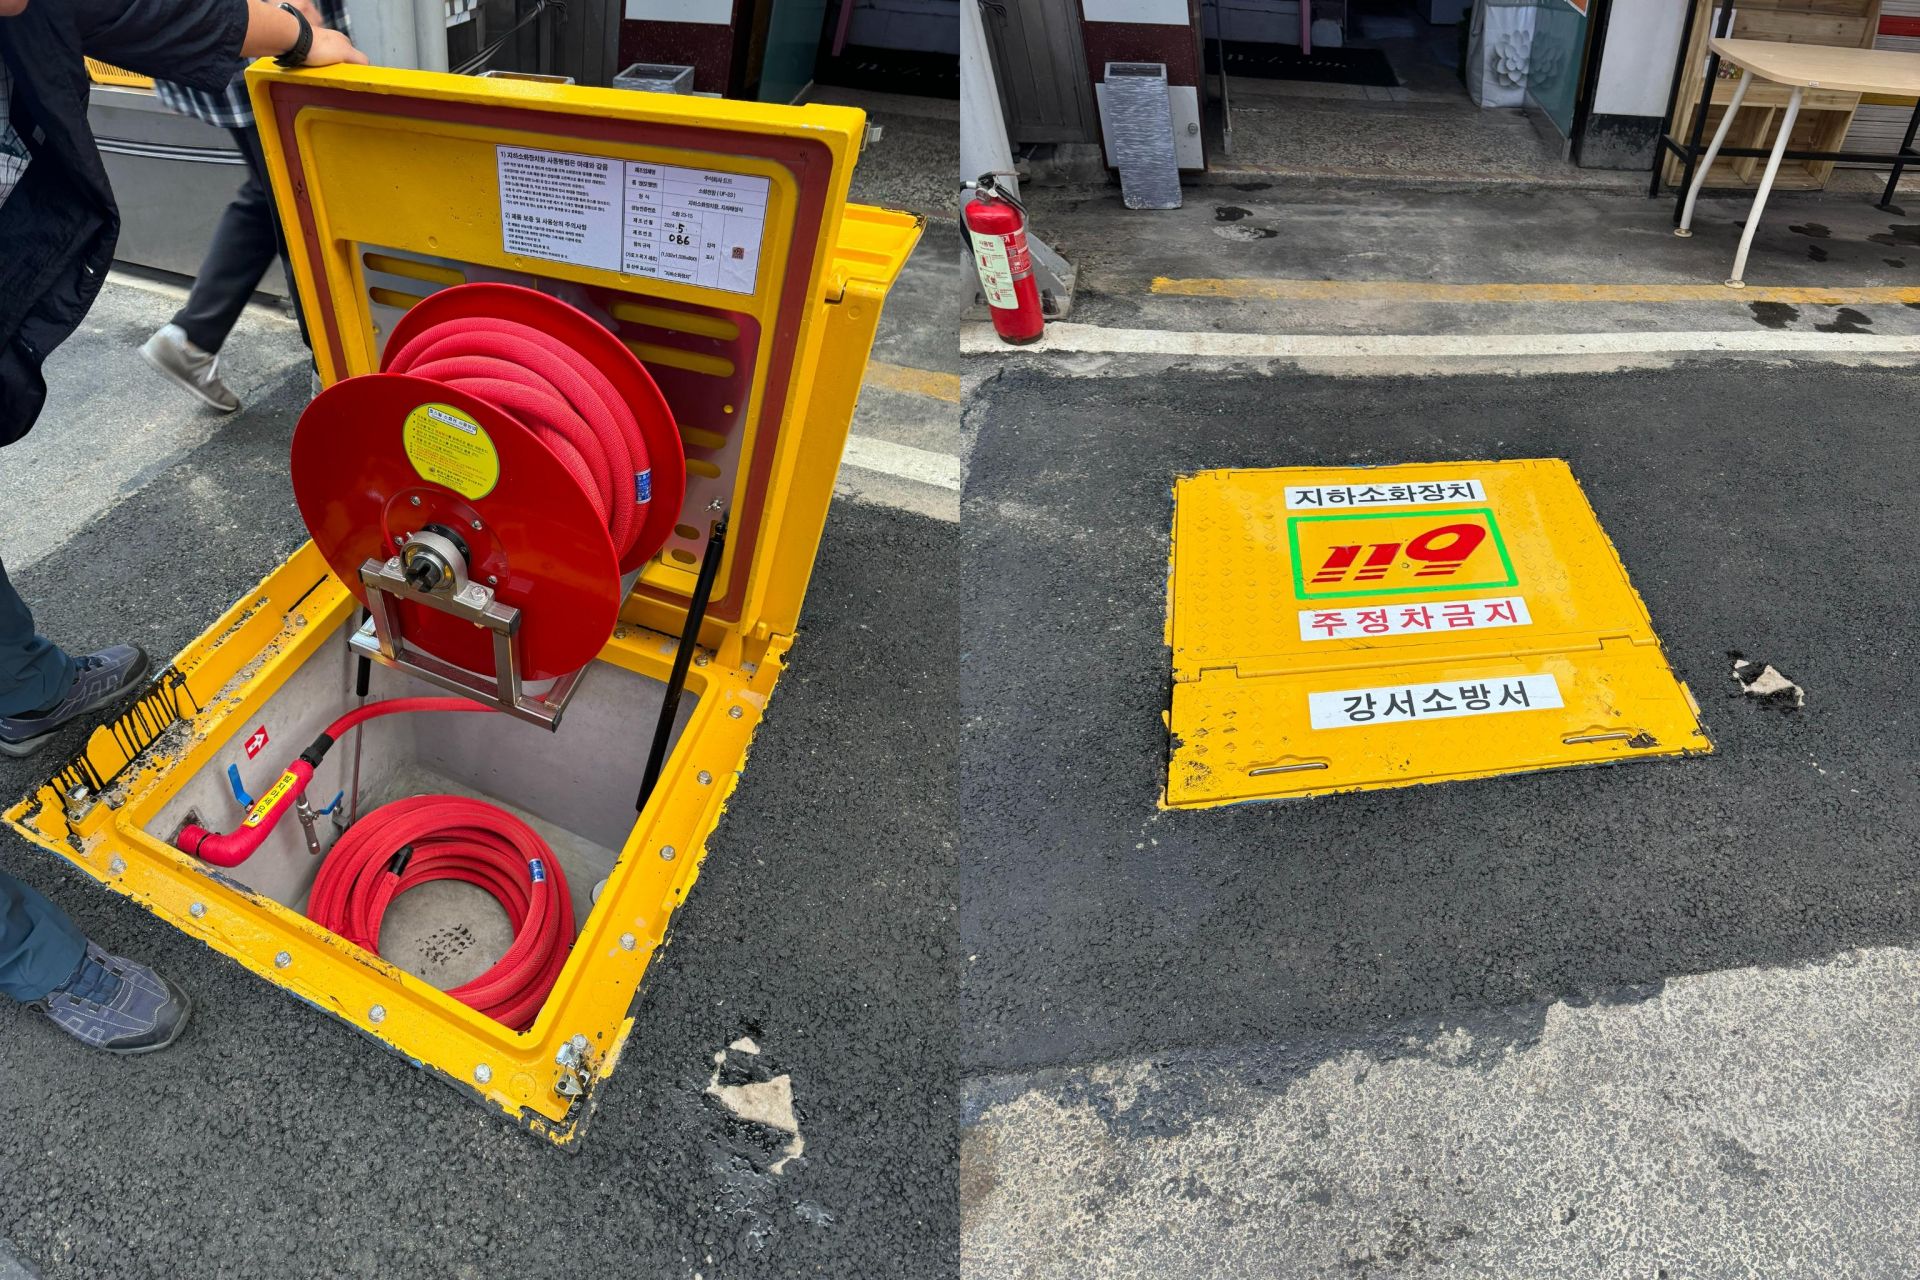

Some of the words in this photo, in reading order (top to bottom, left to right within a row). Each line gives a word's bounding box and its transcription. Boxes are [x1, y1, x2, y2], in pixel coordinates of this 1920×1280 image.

[576, 160, 595, 169] 아래와
[596, 163, 609, 171] 같음
[703, 175, 723, 184] 주식회사
[564, 220, 587, 231] 주의사항
[668, 233, 691, 246] 086
[1294, 481, 1477, 507] 지하소화장치
[1310, 523, 1487, 584] 119
[1311, 599, 1519, 637] 주정차금지
[1343, 680, 1532, 722] 강서소방서
